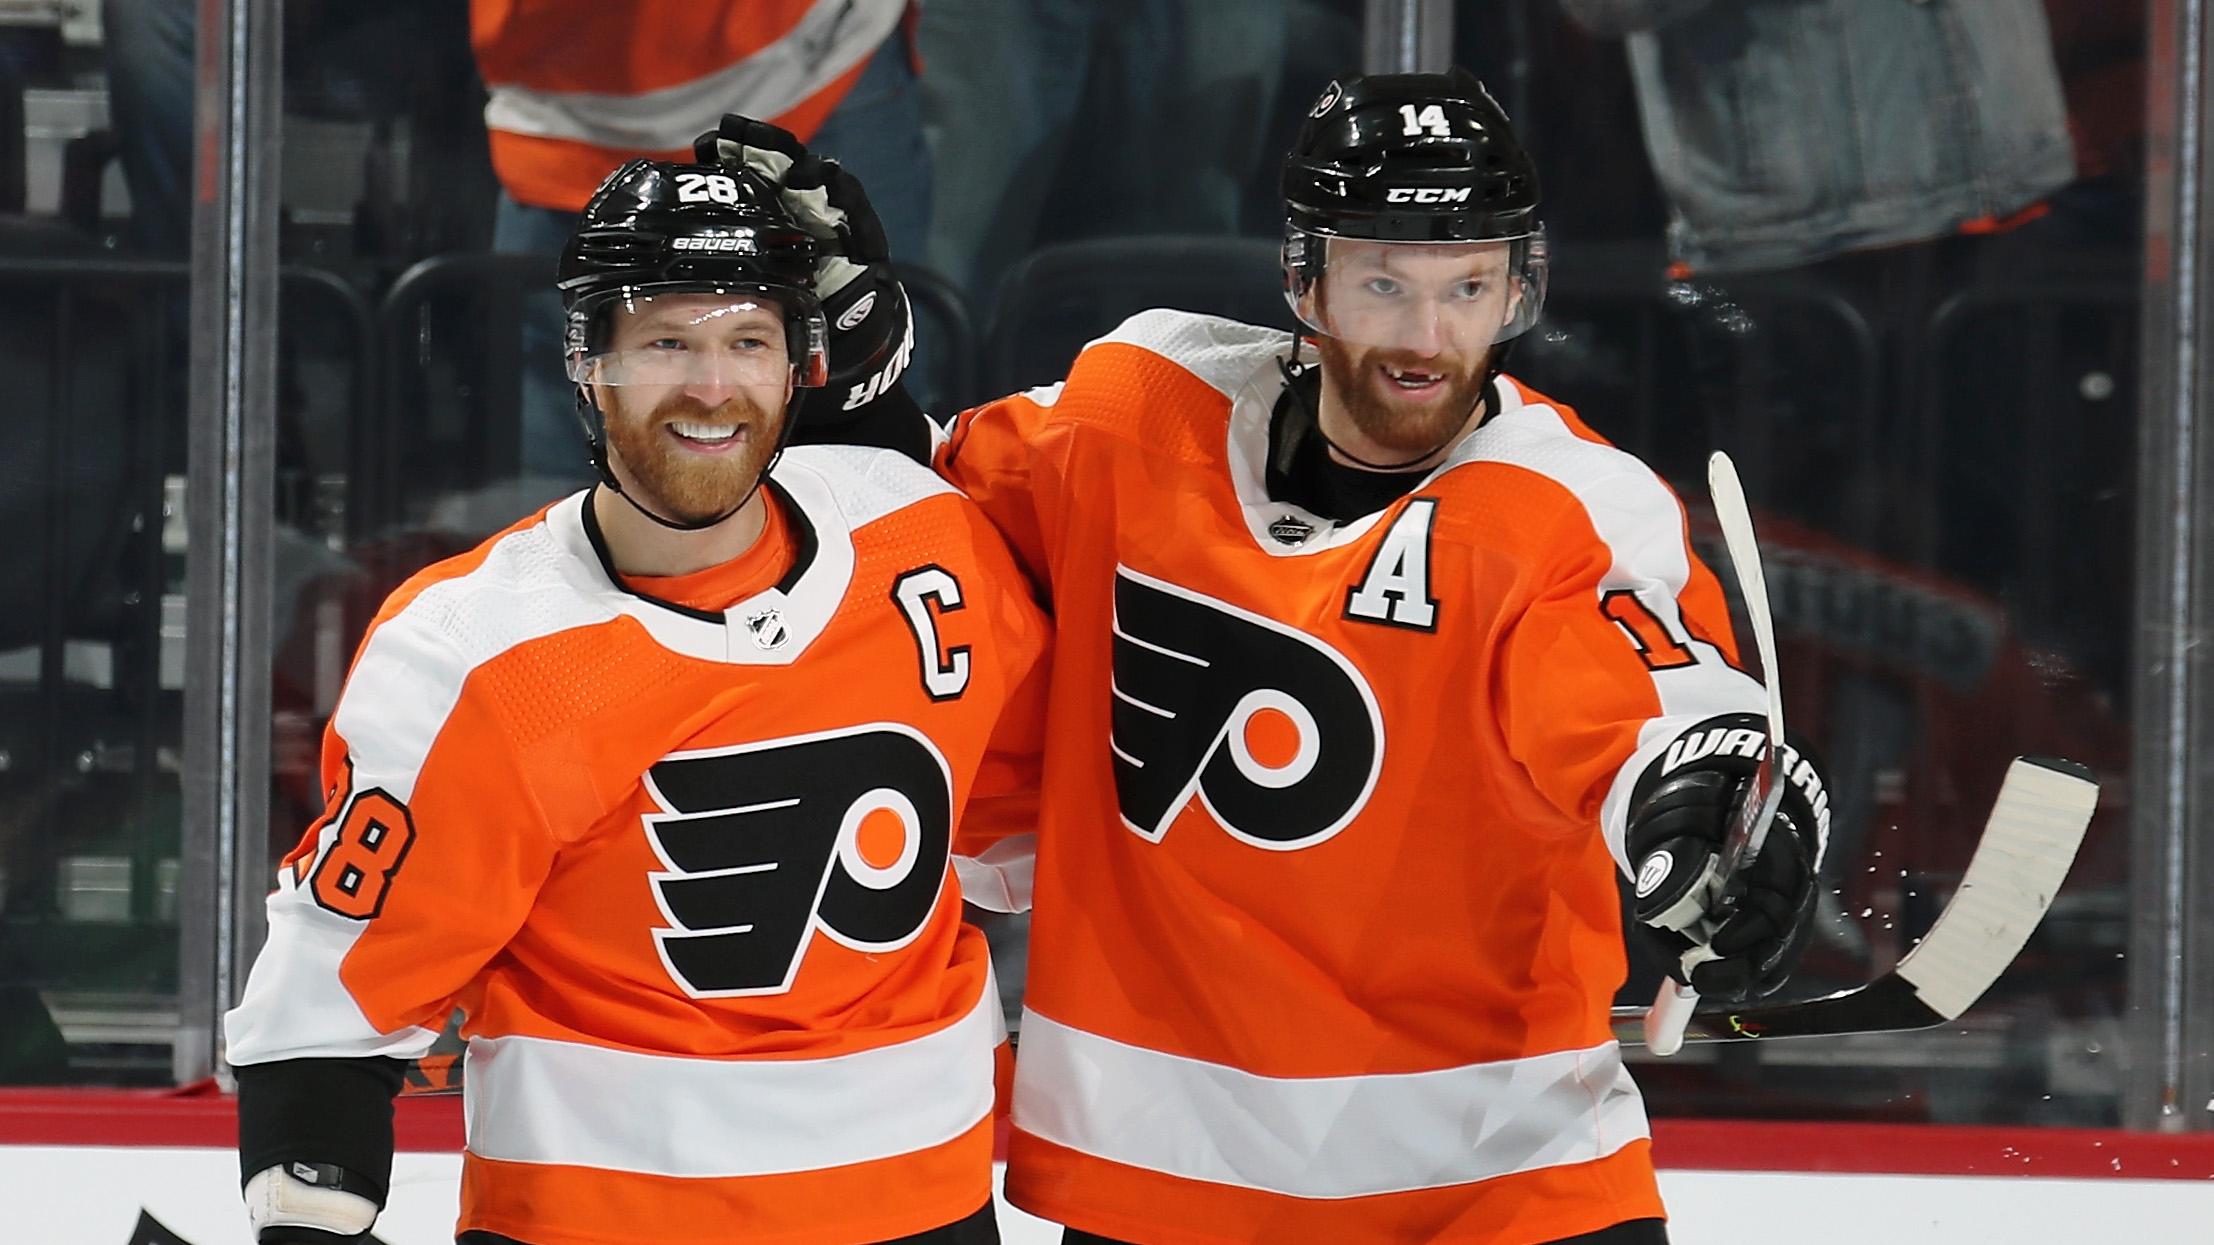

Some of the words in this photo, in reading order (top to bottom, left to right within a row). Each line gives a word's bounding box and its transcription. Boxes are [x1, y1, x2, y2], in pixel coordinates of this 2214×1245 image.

[1398, 104, 1450, 136] 14
[675, 174, 738, 206] 28
[1387, 187, 1472, 203] CCM
[1342, 497, 1440, 633] A
[890, 563, 971, 703] C
